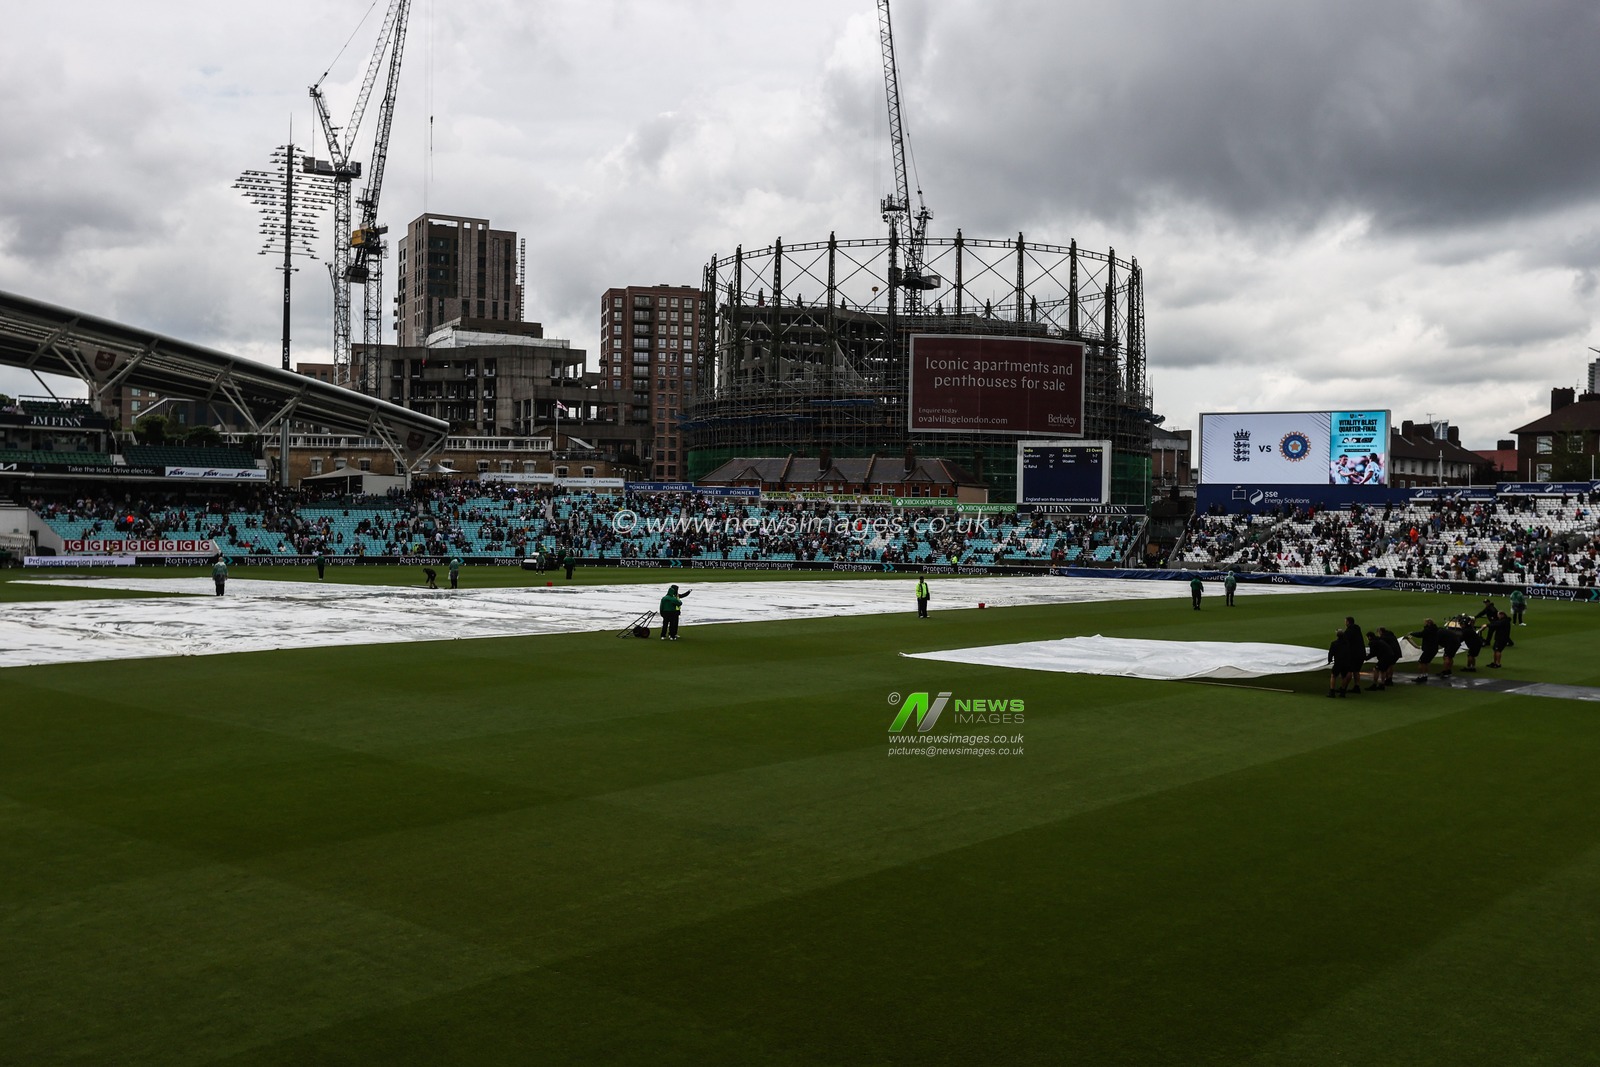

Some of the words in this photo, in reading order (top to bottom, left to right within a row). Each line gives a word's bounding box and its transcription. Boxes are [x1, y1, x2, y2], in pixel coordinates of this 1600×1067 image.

[926, 356, 968, 370] Iconic
[973, 358, 1049, 374] apartments
[1052, 364, 1072, 376] and
[934, 374, 1017, 388] penthouses
[1021, 376, 1040, 389] for
[1043, 379, 1066, 392] sale
[30, 416, 48, 425] JM
[52, 417, 82, 427] FINN
[918, 415, 1008, 424] ovalvillagelondon.com
[1048, 414, 1076, 428] Berkeley
[68, 541, 81, 550] IG
[88, 541, 100, 550] IG
[126, 541, 138, 550] IG
[144, 541, 156, 550] IG
[162, 541, 174, 550] IG
[180, 541, 193, 550] IG
[198, 541, 210, 550] IG
[165, 557, 208, 565] Rothesay
[1526, 586, 1577, 598] Rothesay
